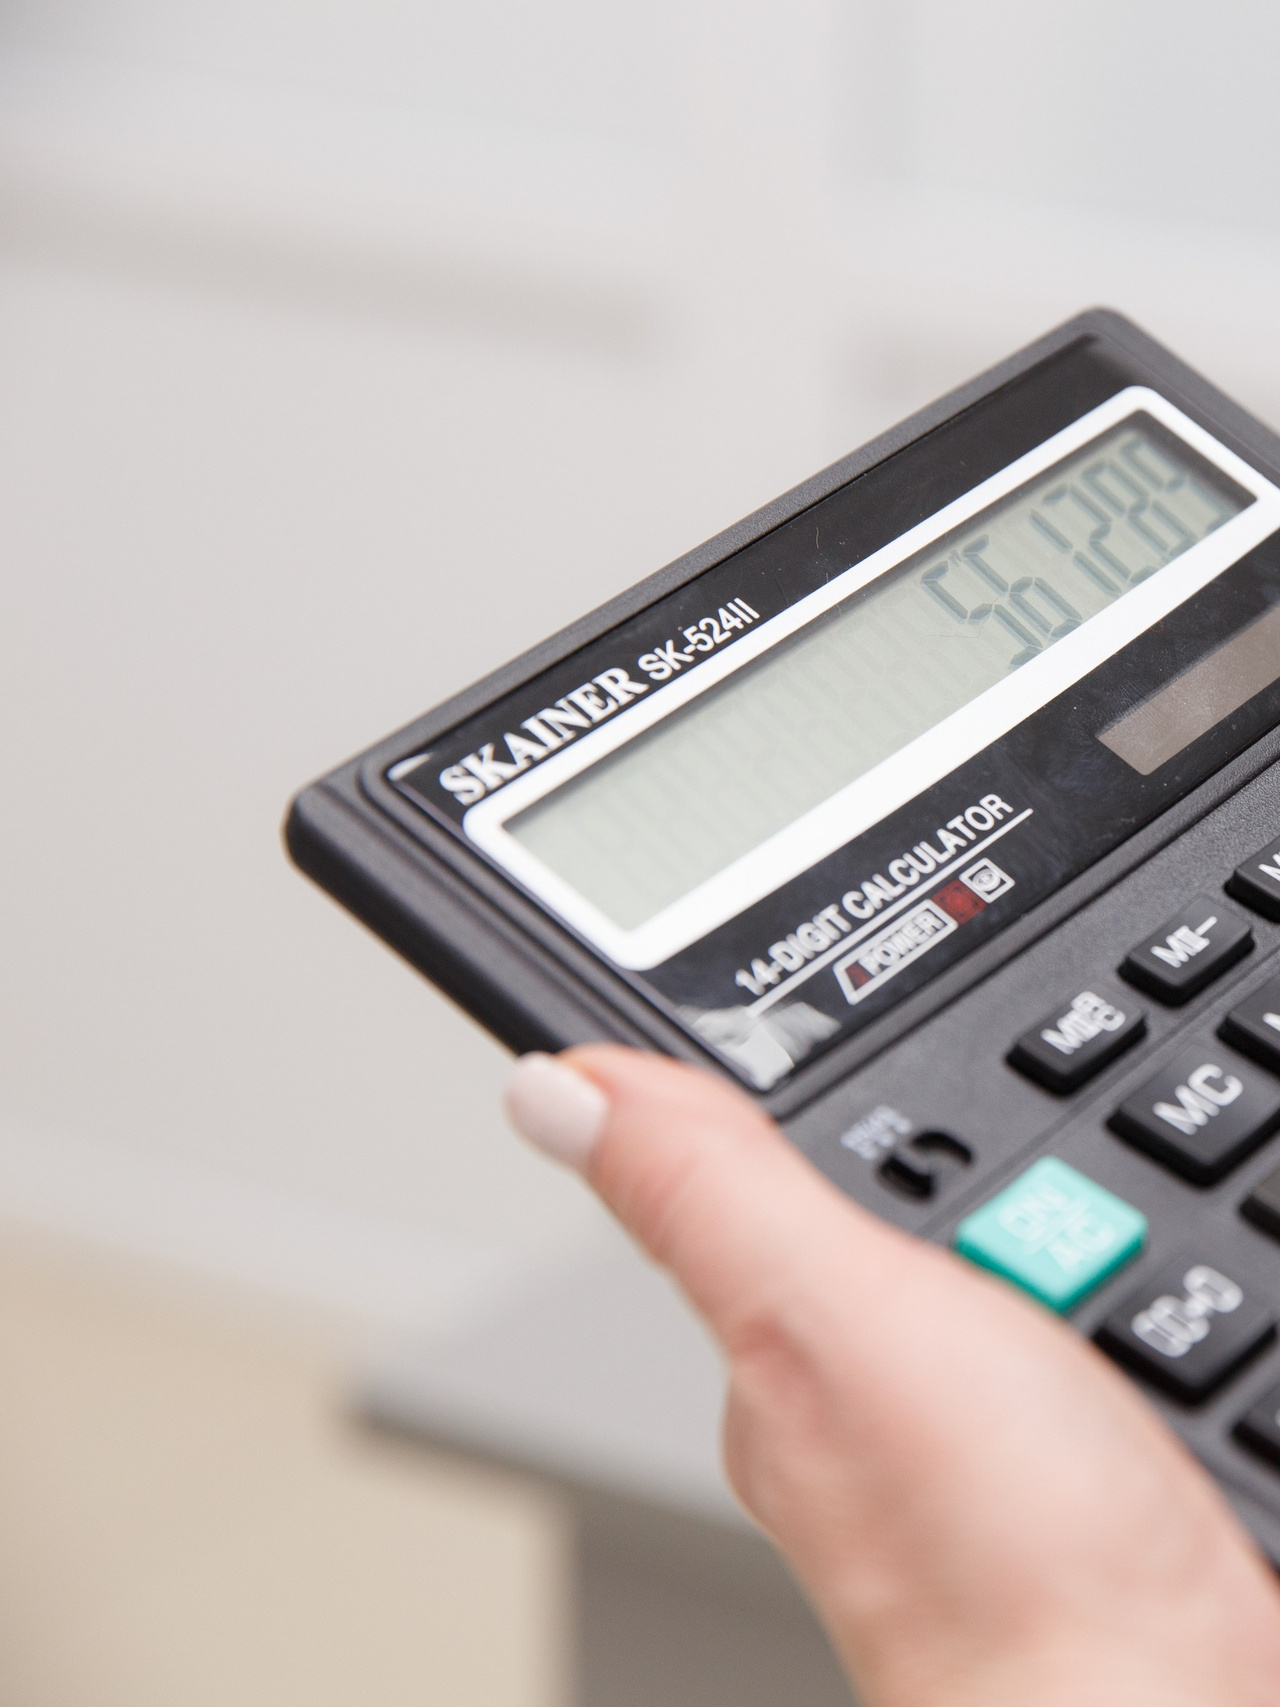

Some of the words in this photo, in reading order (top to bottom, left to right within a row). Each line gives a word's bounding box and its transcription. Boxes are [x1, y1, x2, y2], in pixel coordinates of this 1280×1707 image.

[438, 667, 650, 807] SKAINER
[637, 597, 762, 681] SK-524II
[735, 903, 852, 996] 14-DIGIT
[842, 793, 1014, 919] CALCULATOR
[857, 909, 946, 977] POWER
[1153, 1063, 1243, 1135] MC
